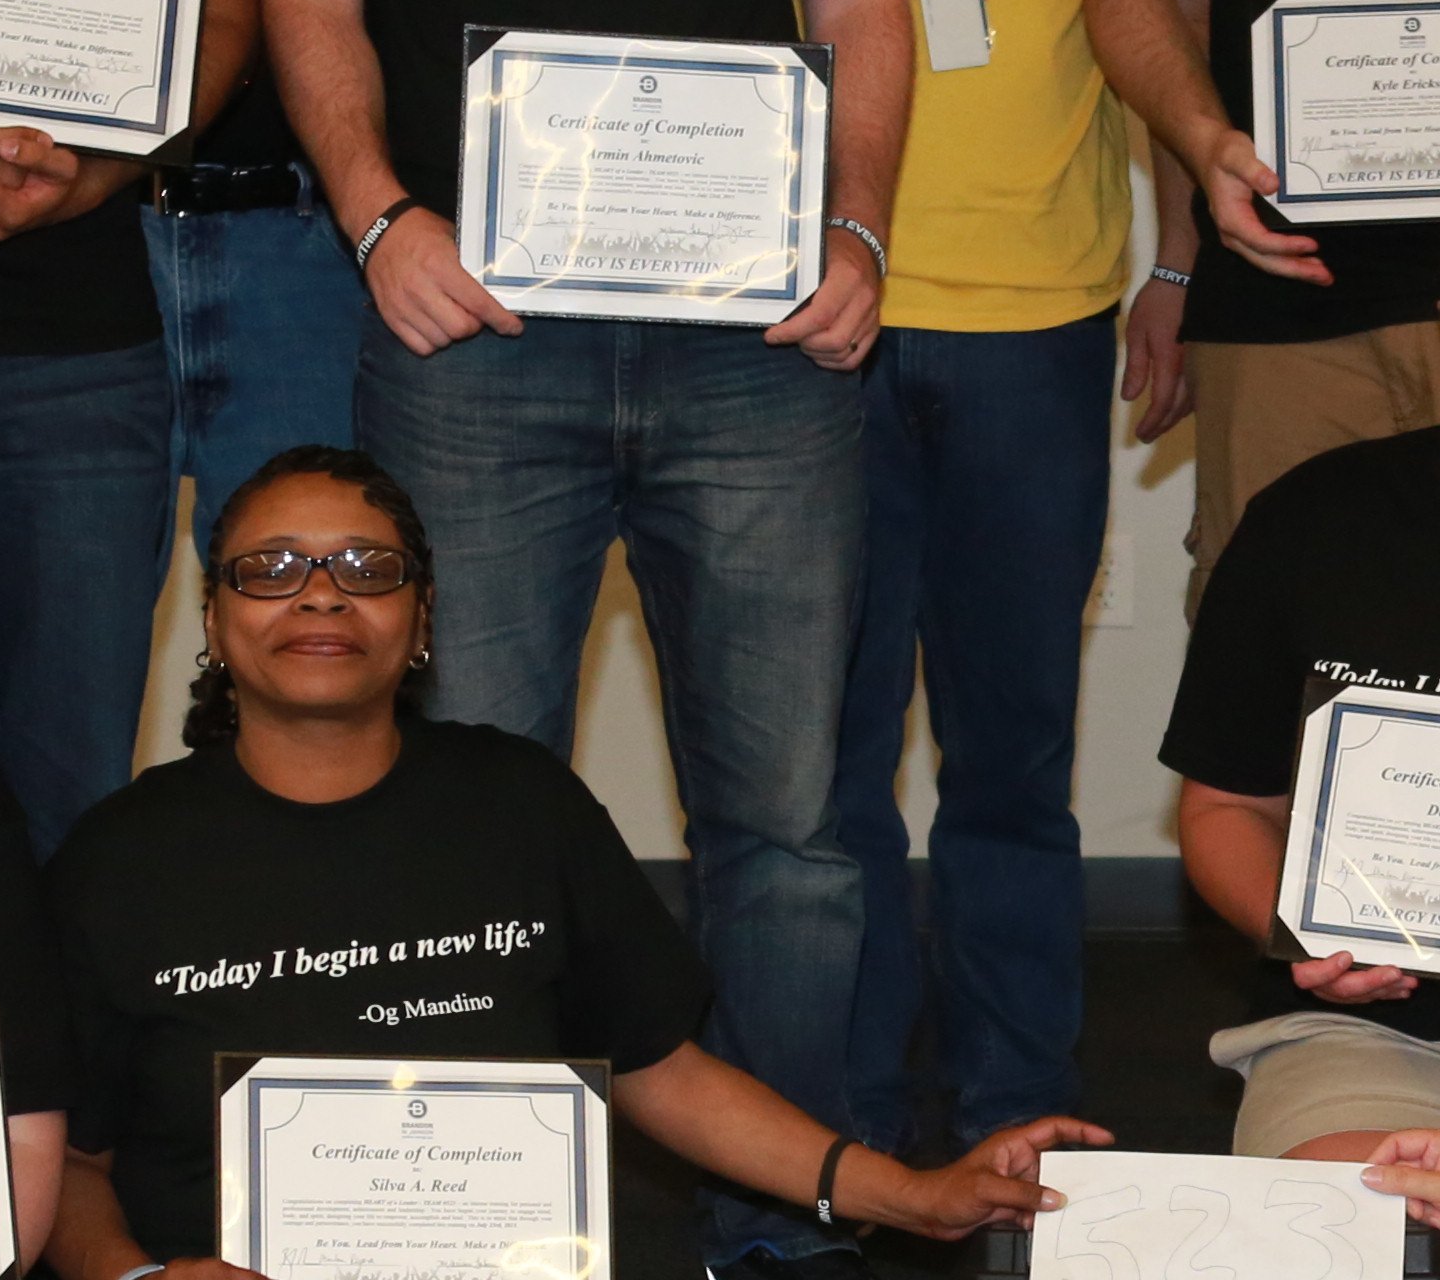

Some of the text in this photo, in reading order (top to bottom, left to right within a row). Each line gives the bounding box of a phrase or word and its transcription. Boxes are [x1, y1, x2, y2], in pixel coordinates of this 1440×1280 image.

[270, 951, 286, 977] I
[295, 940, 378, 977] begin
[389, 942, 407, 962] a
[417, 934, 475, 958] new
[359, 993, 493, 1025] -Og Mandino
